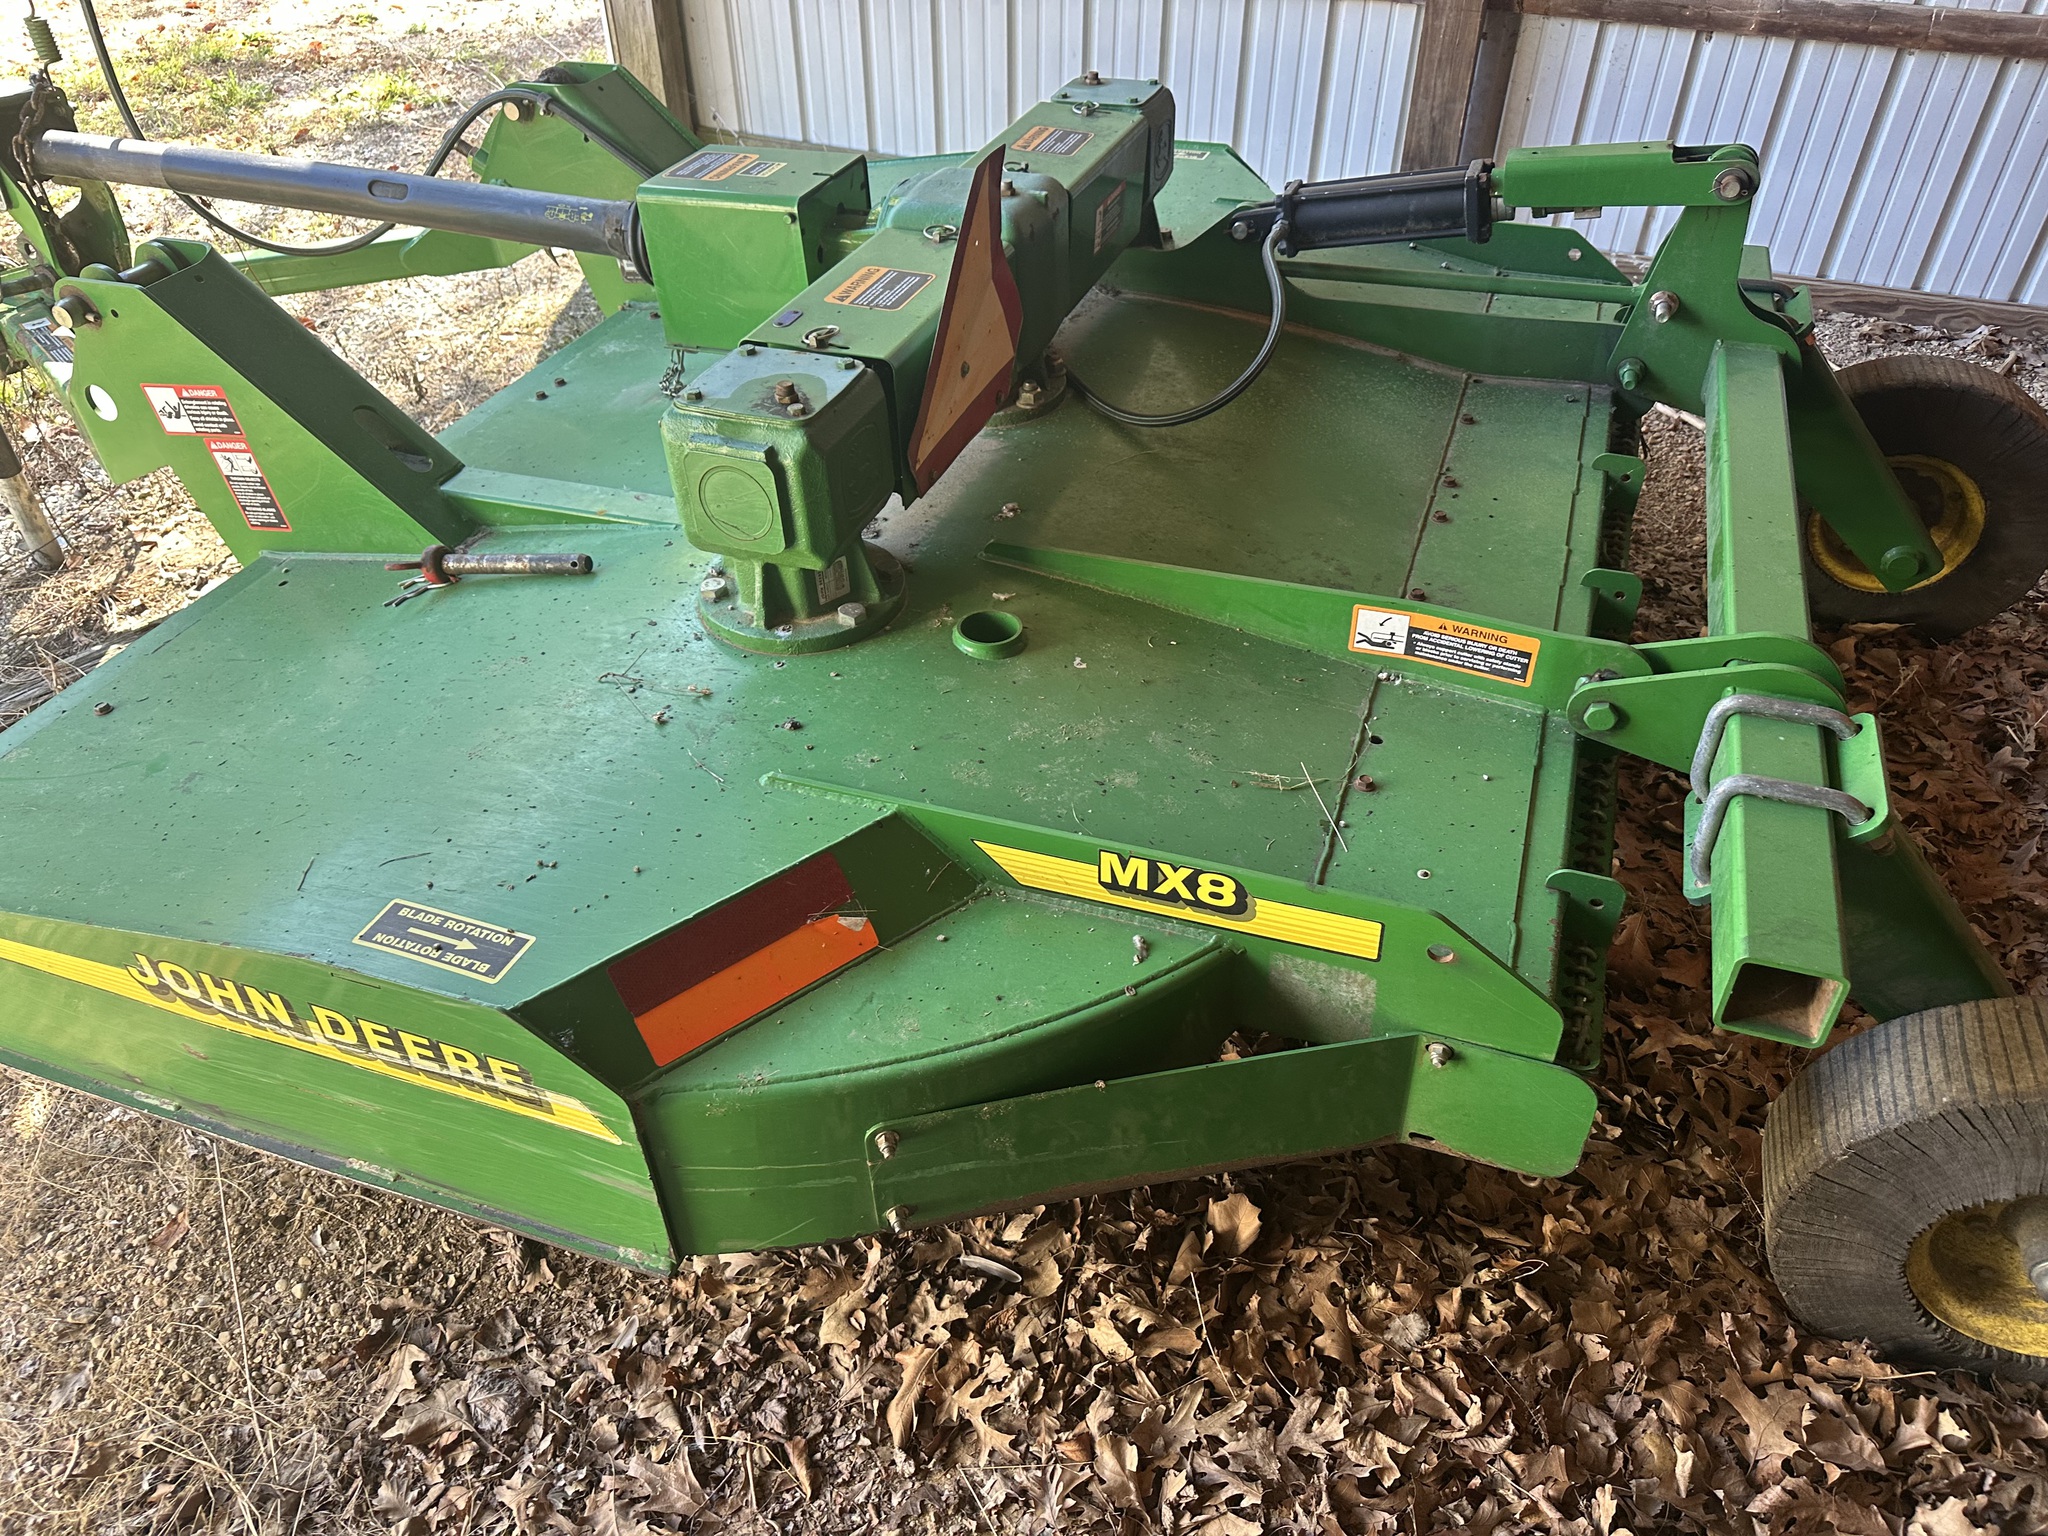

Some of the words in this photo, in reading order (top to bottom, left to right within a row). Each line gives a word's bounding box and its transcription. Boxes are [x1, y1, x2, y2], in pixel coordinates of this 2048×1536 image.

[840, 267, 881, 299] WARNING
[188, 389, 218, 397] DANGER
[216, 442, 248, 450] DANGER
[1412, 633, 1429, 641] FROM
[1429, 638, 1464, 650] ACCIDENTAL
[1464, 645, 1496, 657] LOWERING
[1505, 654, 1529, 664] CUTTER
[1423, 631, 1441, 639] AVOID
[1441, 635, 1466, 645] SERIOUS
[1467, 640, 1488, 649] INJURY
[1498, 647, 1518, 655] DEATH
[1452, 624, 1508, 645] WARNING
[1099, 850, 1244, 912] MX8
[398, 907, 445, 927] BLADE
[443, 917, 516, 947] ROTATION
[372, 932, 443, 960] ROTATION
[441, 952, 491, 974] BLADE
[126, 952, 295, 1029] JOHN
[309, 1002, 530, 1088] DEERE
